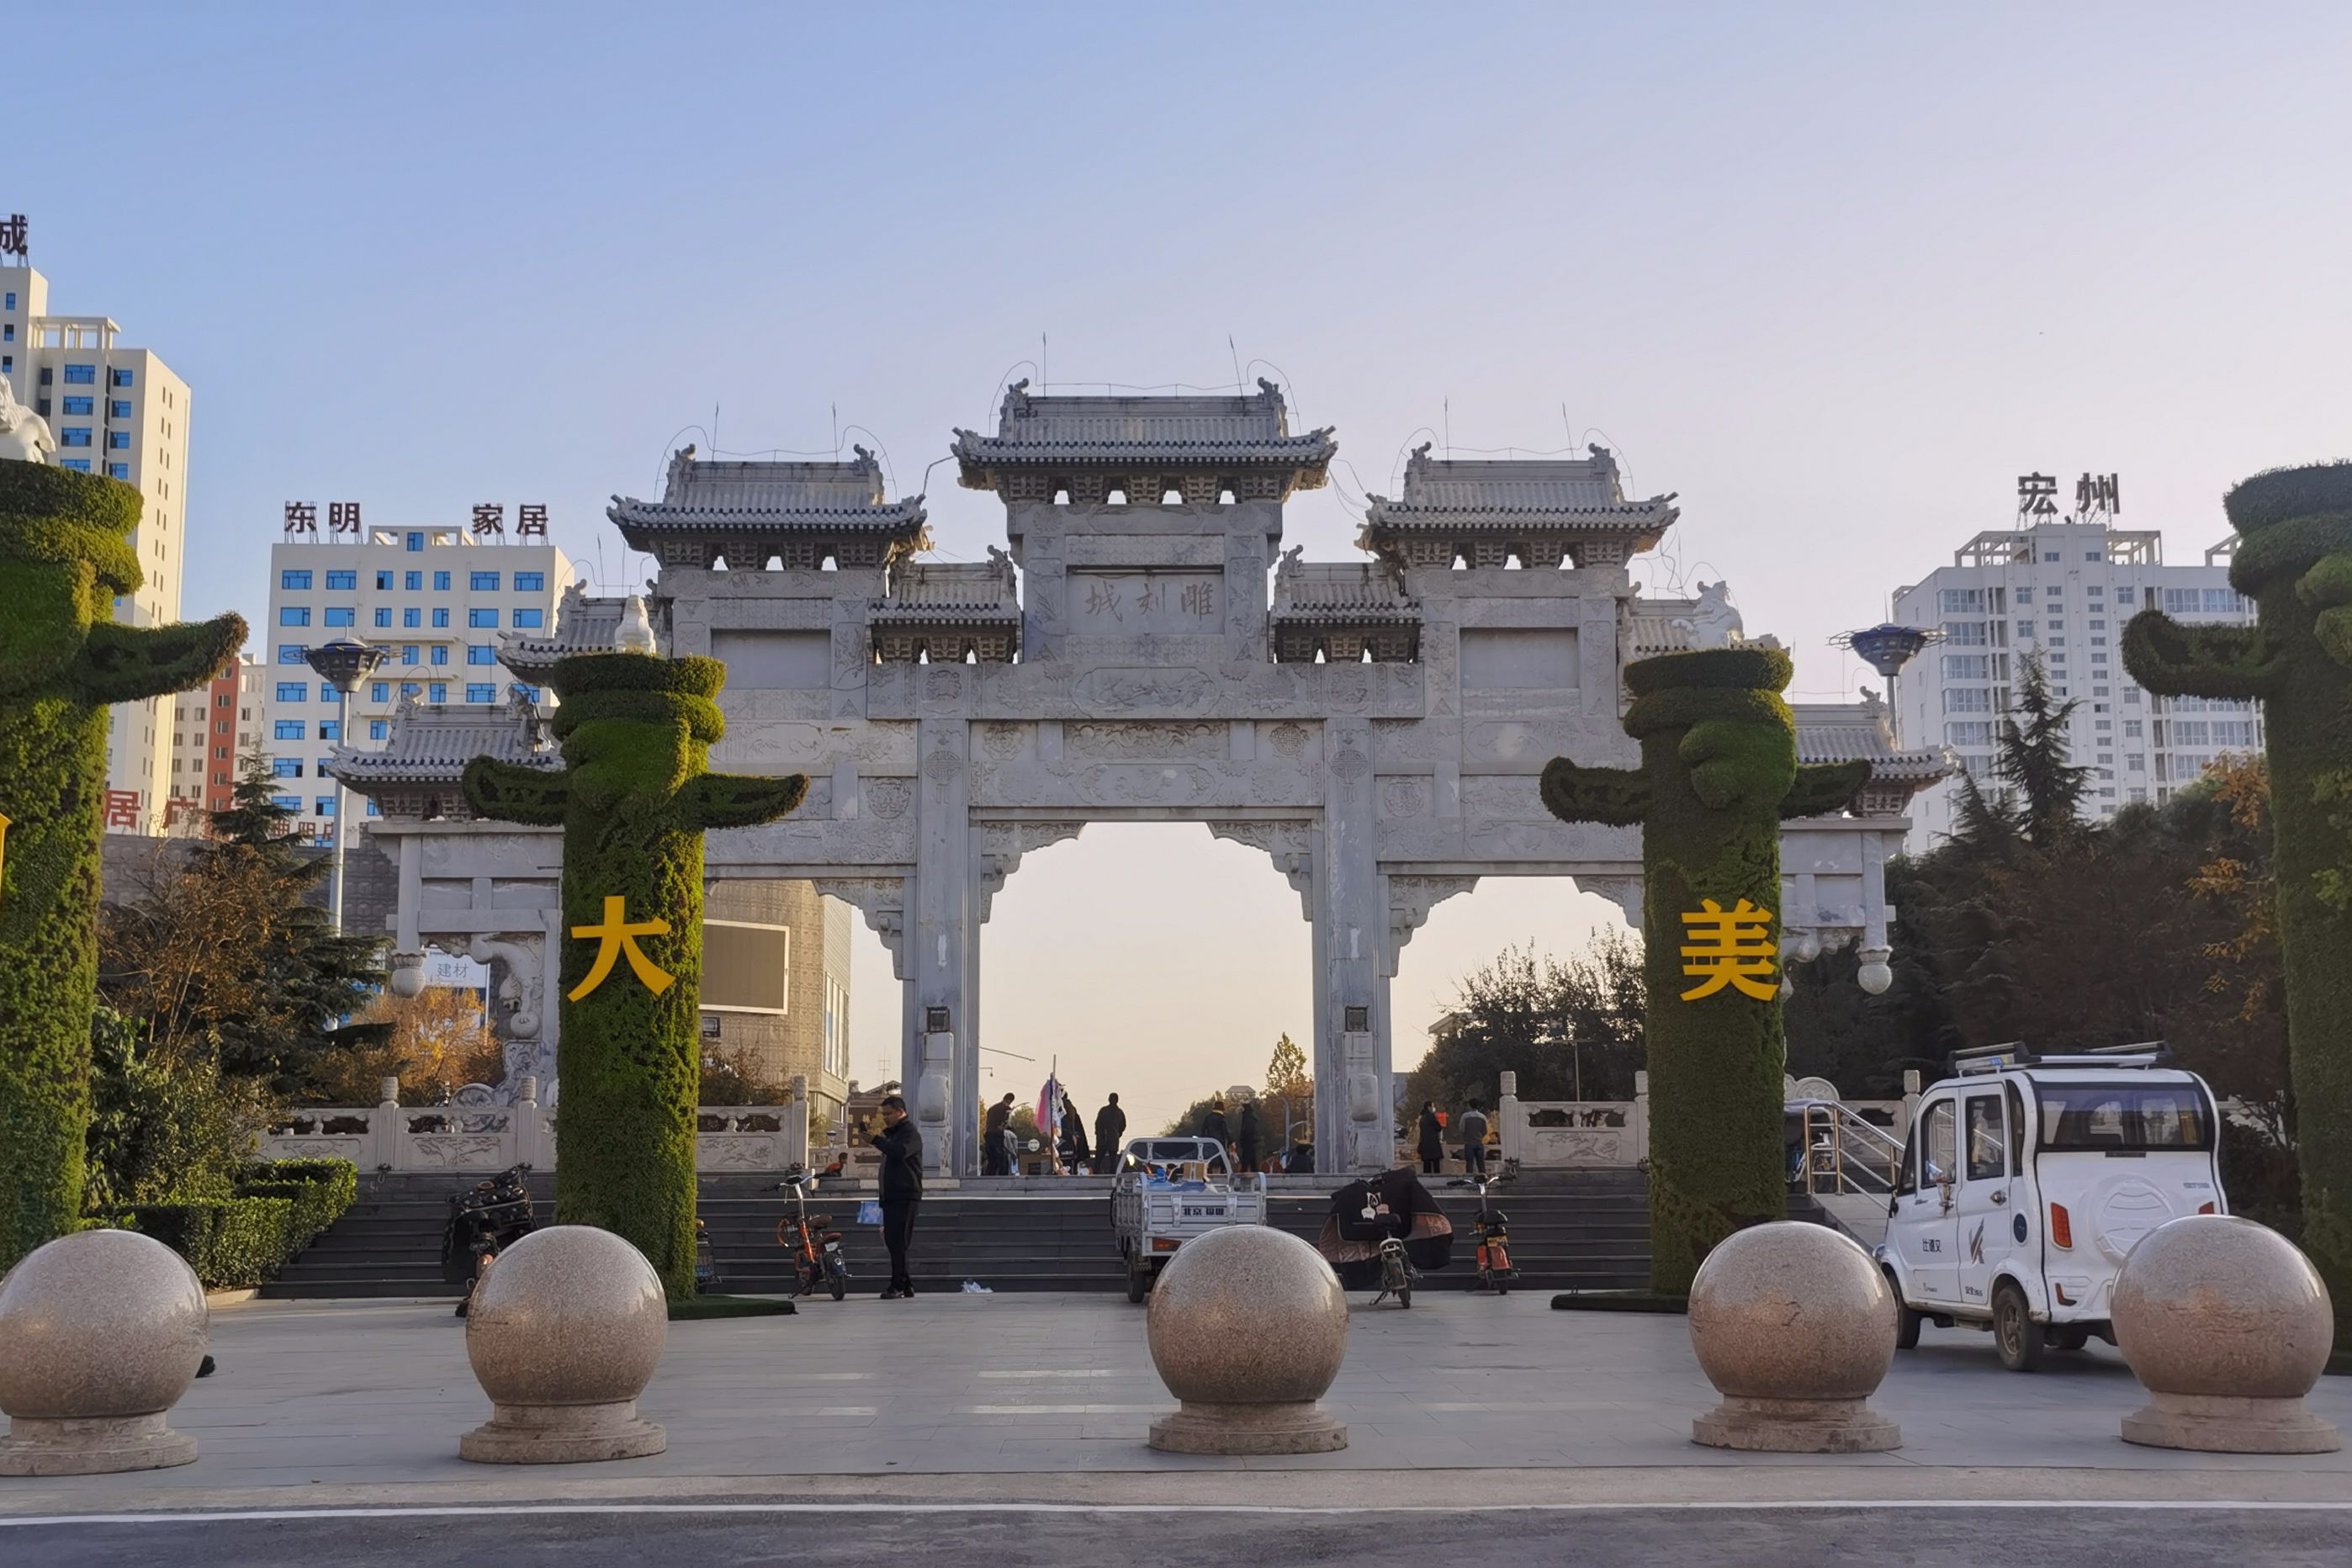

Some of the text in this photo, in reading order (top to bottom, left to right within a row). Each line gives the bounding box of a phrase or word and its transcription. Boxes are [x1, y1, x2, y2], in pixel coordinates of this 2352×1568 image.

[2017, 471, 2120, 515] 宏州
[284, 501, 548, 536] 东明 家居
[437, 962, 469, 978] 建材
[567, 895, 675, 1003] 大
[1680, 898, 1780, 1001] 美
